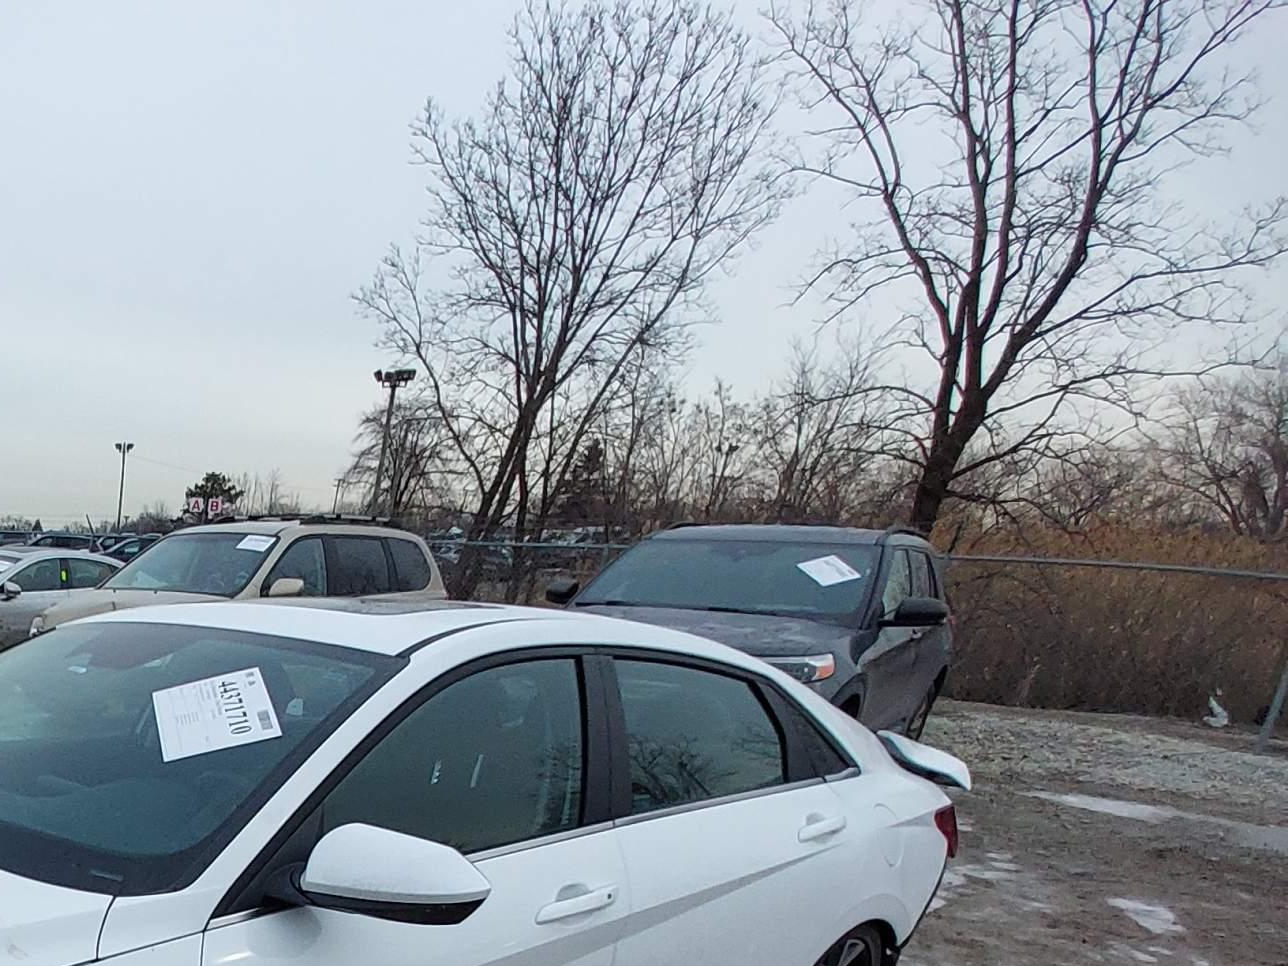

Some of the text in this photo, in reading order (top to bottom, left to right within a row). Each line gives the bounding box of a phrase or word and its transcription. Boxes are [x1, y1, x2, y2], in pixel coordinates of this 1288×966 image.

[192, 499, 201, 511] A
[210, 500, 220, 512] B
[218, 681, 253, 735] 44371710
